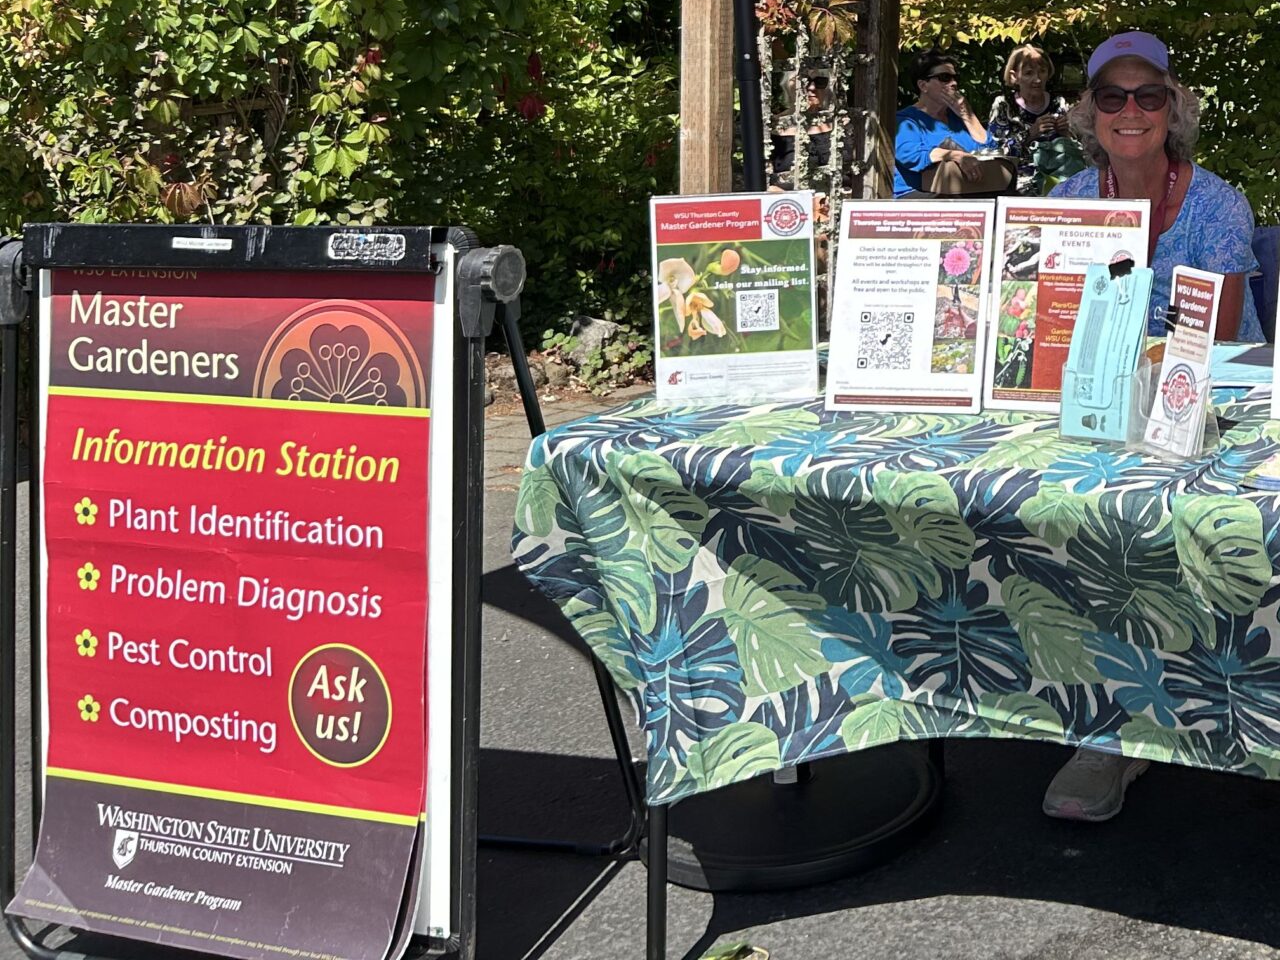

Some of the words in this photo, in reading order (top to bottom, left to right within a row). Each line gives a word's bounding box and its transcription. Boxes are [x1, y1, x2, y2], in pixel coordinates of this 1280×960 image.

[660, 222, 688, 231] Master
[689, 221, 724, 230] Gardener
[725, 219, 760, 230] Program
[690, 211, 717, 219] Thurston
[717, 210, 740, 218] County
[1057, 215, 1082, 223] Program
[1059, 230, 1104, 238] RESOURCES
[714, 281, 734, 290] Join
[754, 279, 789, 288] mailing
[791, 278, 809, 286] list.
[740, 265, 761, 276] Stay
[764, 264, 809, 273] informed.
[70, 290, 184, 329] Master
[1177, 283, 1192, 297] WSU
[1192, 287, 1214, 301] Master
[1180, 298, 1208, 314] Gardener
[1179, 313, 1205, 328] Program
[67, 336, 240, 379] Gardeners
[72, 428, 266, 474] Information
[276, 441, 401, 483] Station
[109, 498, 180, 534] Plant
[190, 504, 384, 549] Identification
[110, 564, 226, 605] Problem
[237, 576, 383, 621] Diagnosis
[108, 631, 161, 666] Pest
[168, 638, 272, 677] Control
[306, 664, 368, 703] Ask
[109, 697, 277, 754] Composting
[315, 711, 362, 744] us!
[97, 803, 204, 840] WASHINGTON
[204, 820, 250, 848] STATE
[252, 827, 350, 862] UNIVERSITY
[139, 838, 190, 858] THURSTON
[192, 847, 235, 866] COUNTY
[235, 854, 293, 875] EXTENSION
[105, 874, 143, 893] Master
[143, 881, 194, 904] Gardener
[194, 890, 242, 912] Program
